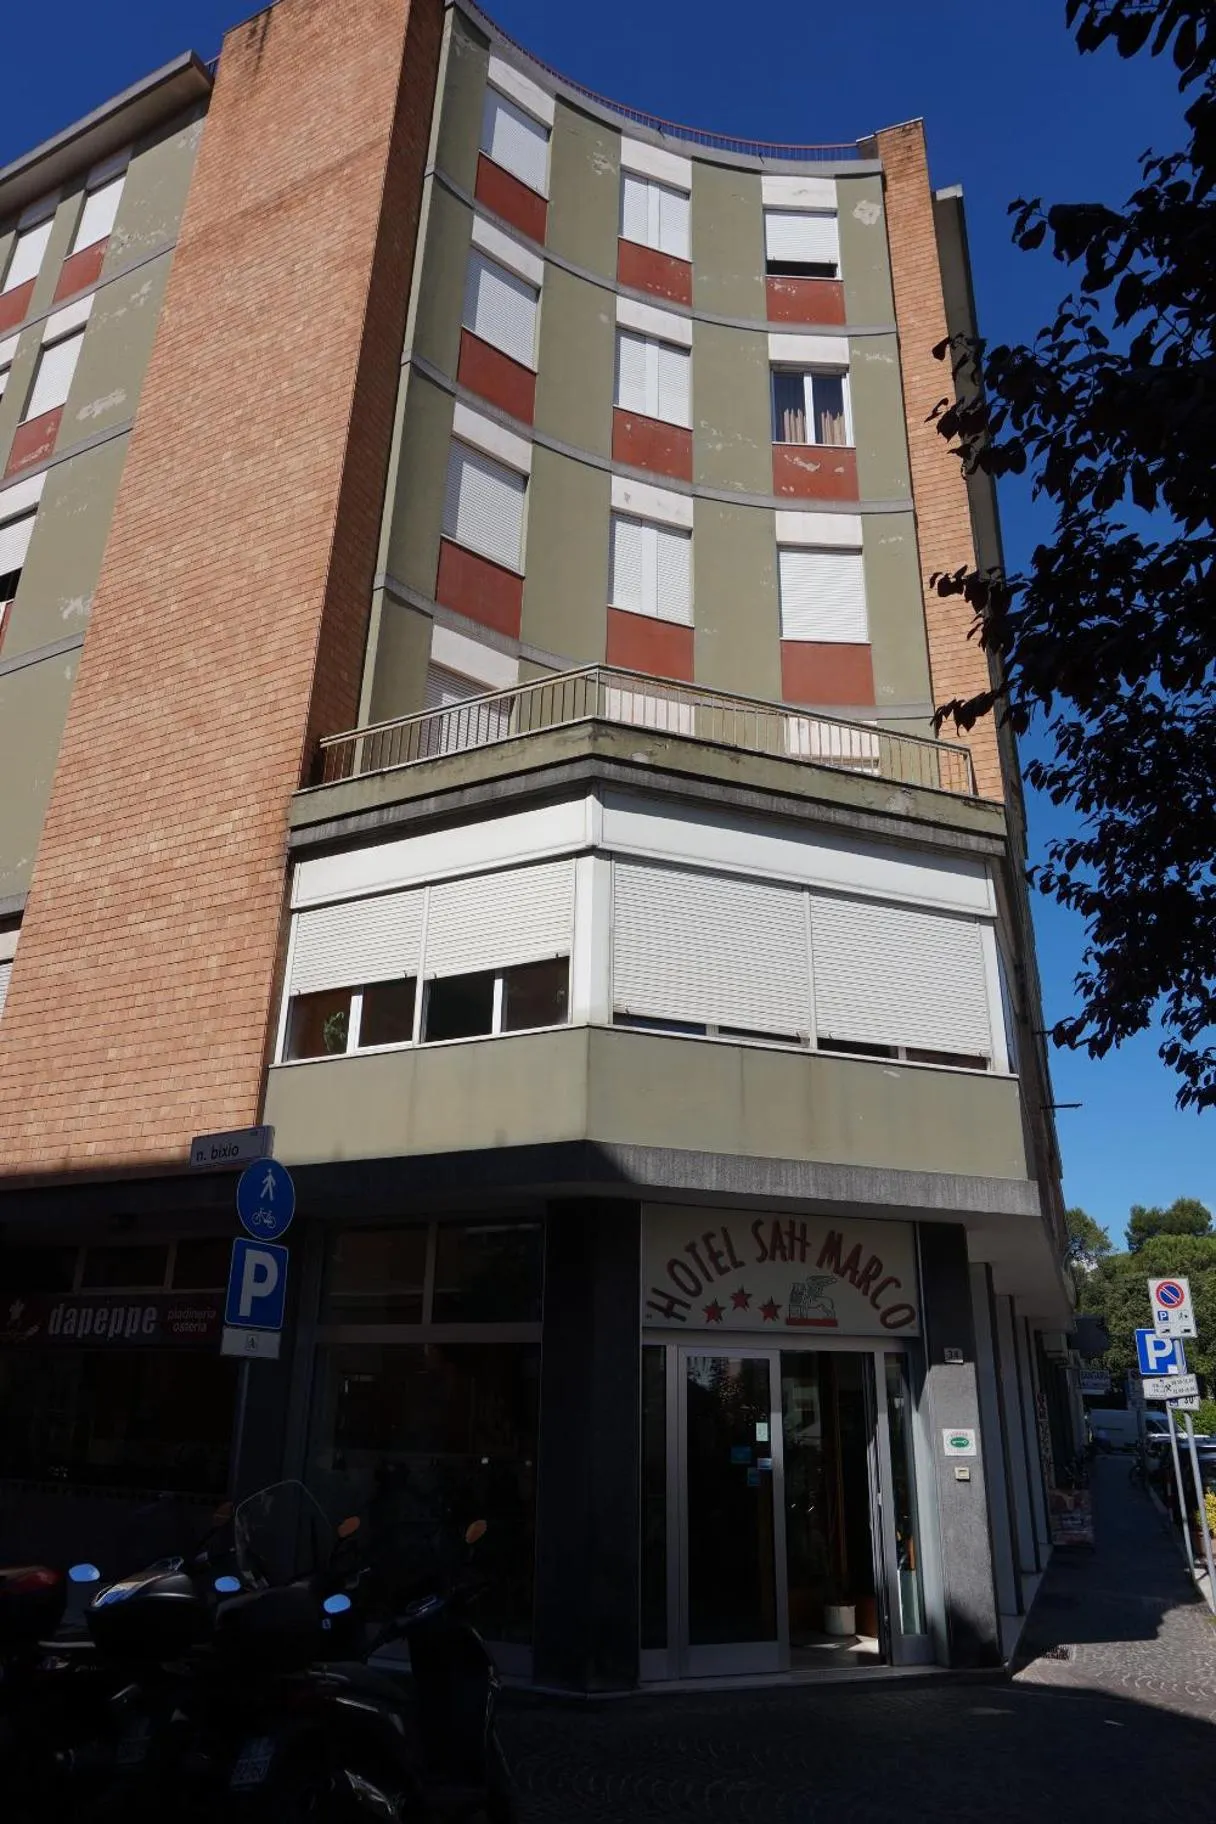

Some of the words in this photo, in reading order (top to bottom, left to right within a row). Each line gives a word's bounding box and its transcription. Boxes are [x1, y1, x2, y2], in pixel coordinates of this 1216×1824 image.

[210, 1143, 239, 1160] bixio
[238, 1247, 279, 1318] P
[646, 1226, 746, 1322] HOTEL
[816, 1229, 917, 1330] MARCO
[1144, 1333, 1173, 1370] P
